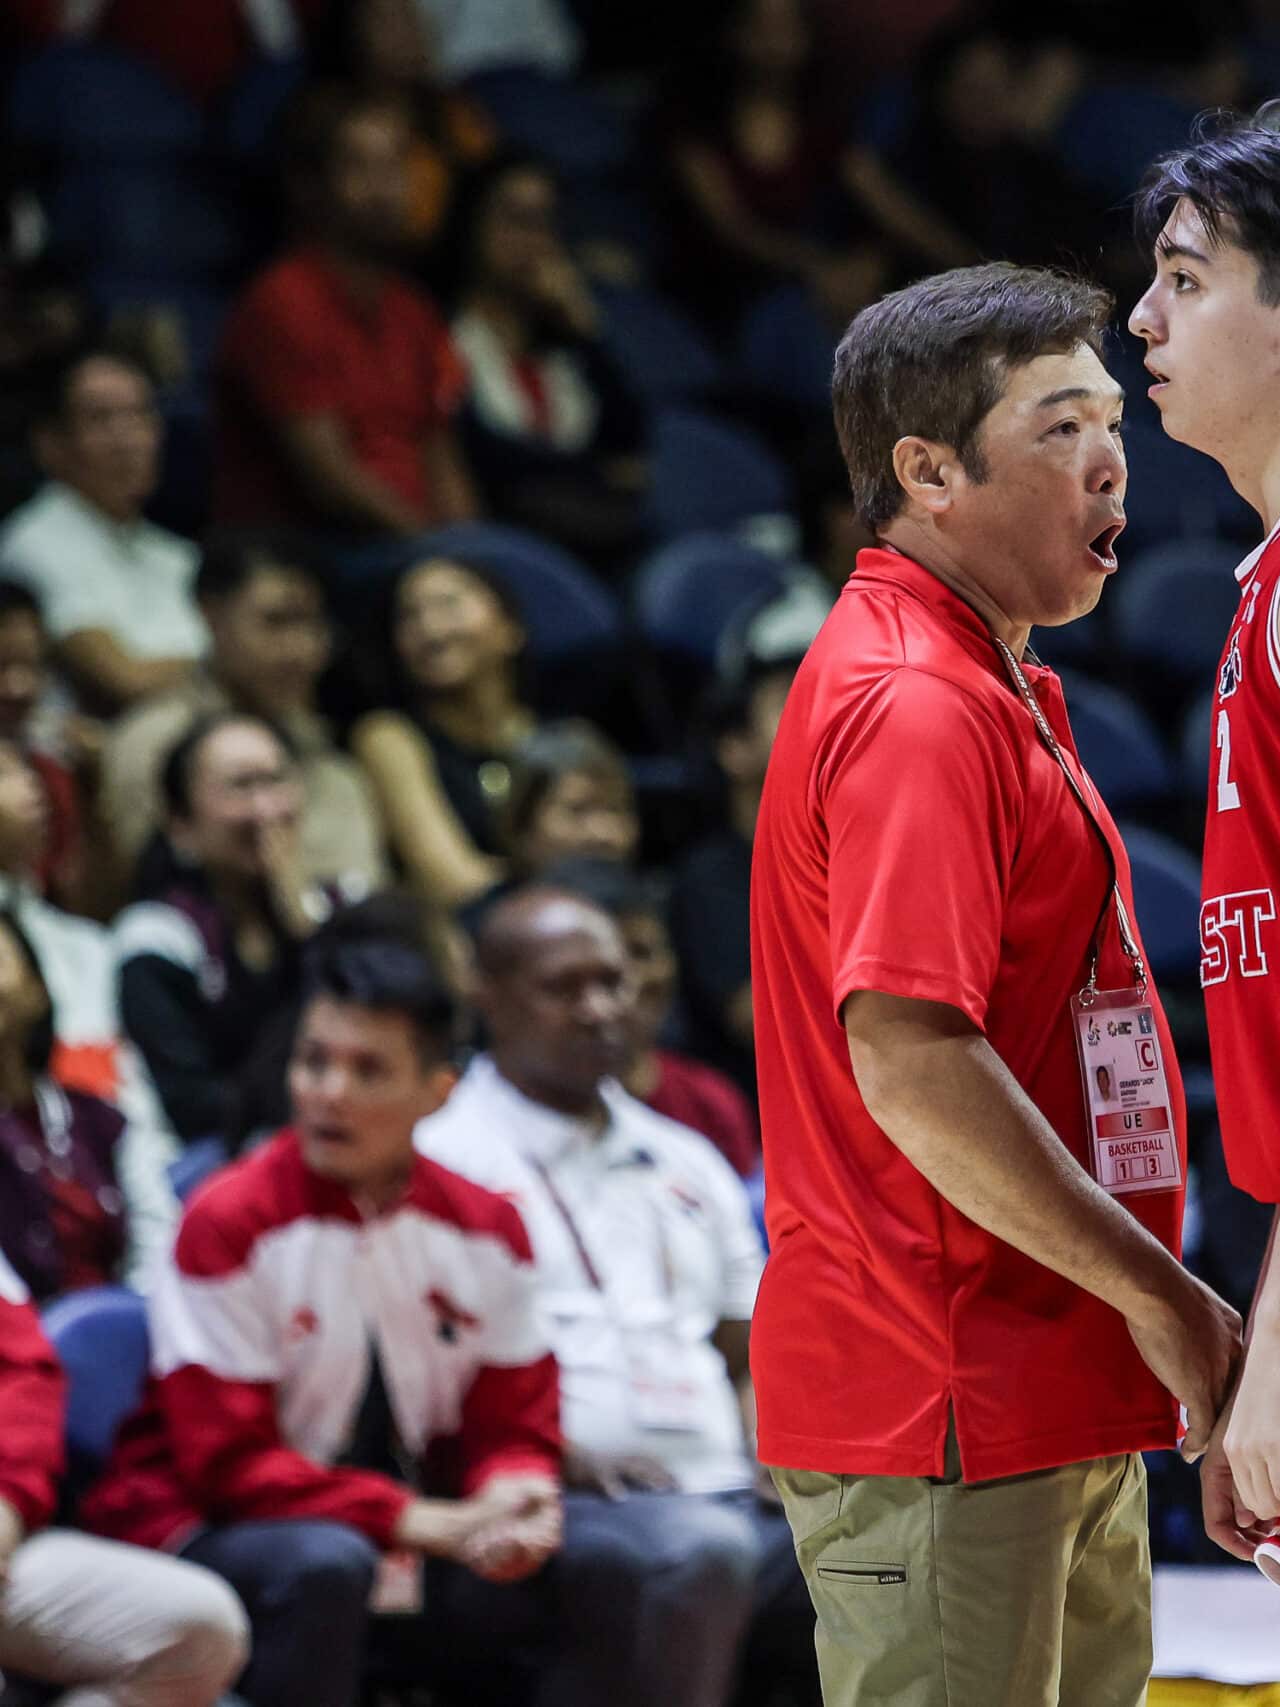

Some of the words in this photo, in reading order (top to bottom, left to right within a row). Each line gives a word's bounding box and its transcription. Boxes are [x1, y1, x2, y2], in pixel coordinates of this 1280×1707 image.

[1141, 1042, 1154, 1068] C
[1108, 1138, 1164, 1157] BASKETBALL
[1120, 1162, 1127, 1179] 1
[1148, 1158, 1158, 1175] 3
